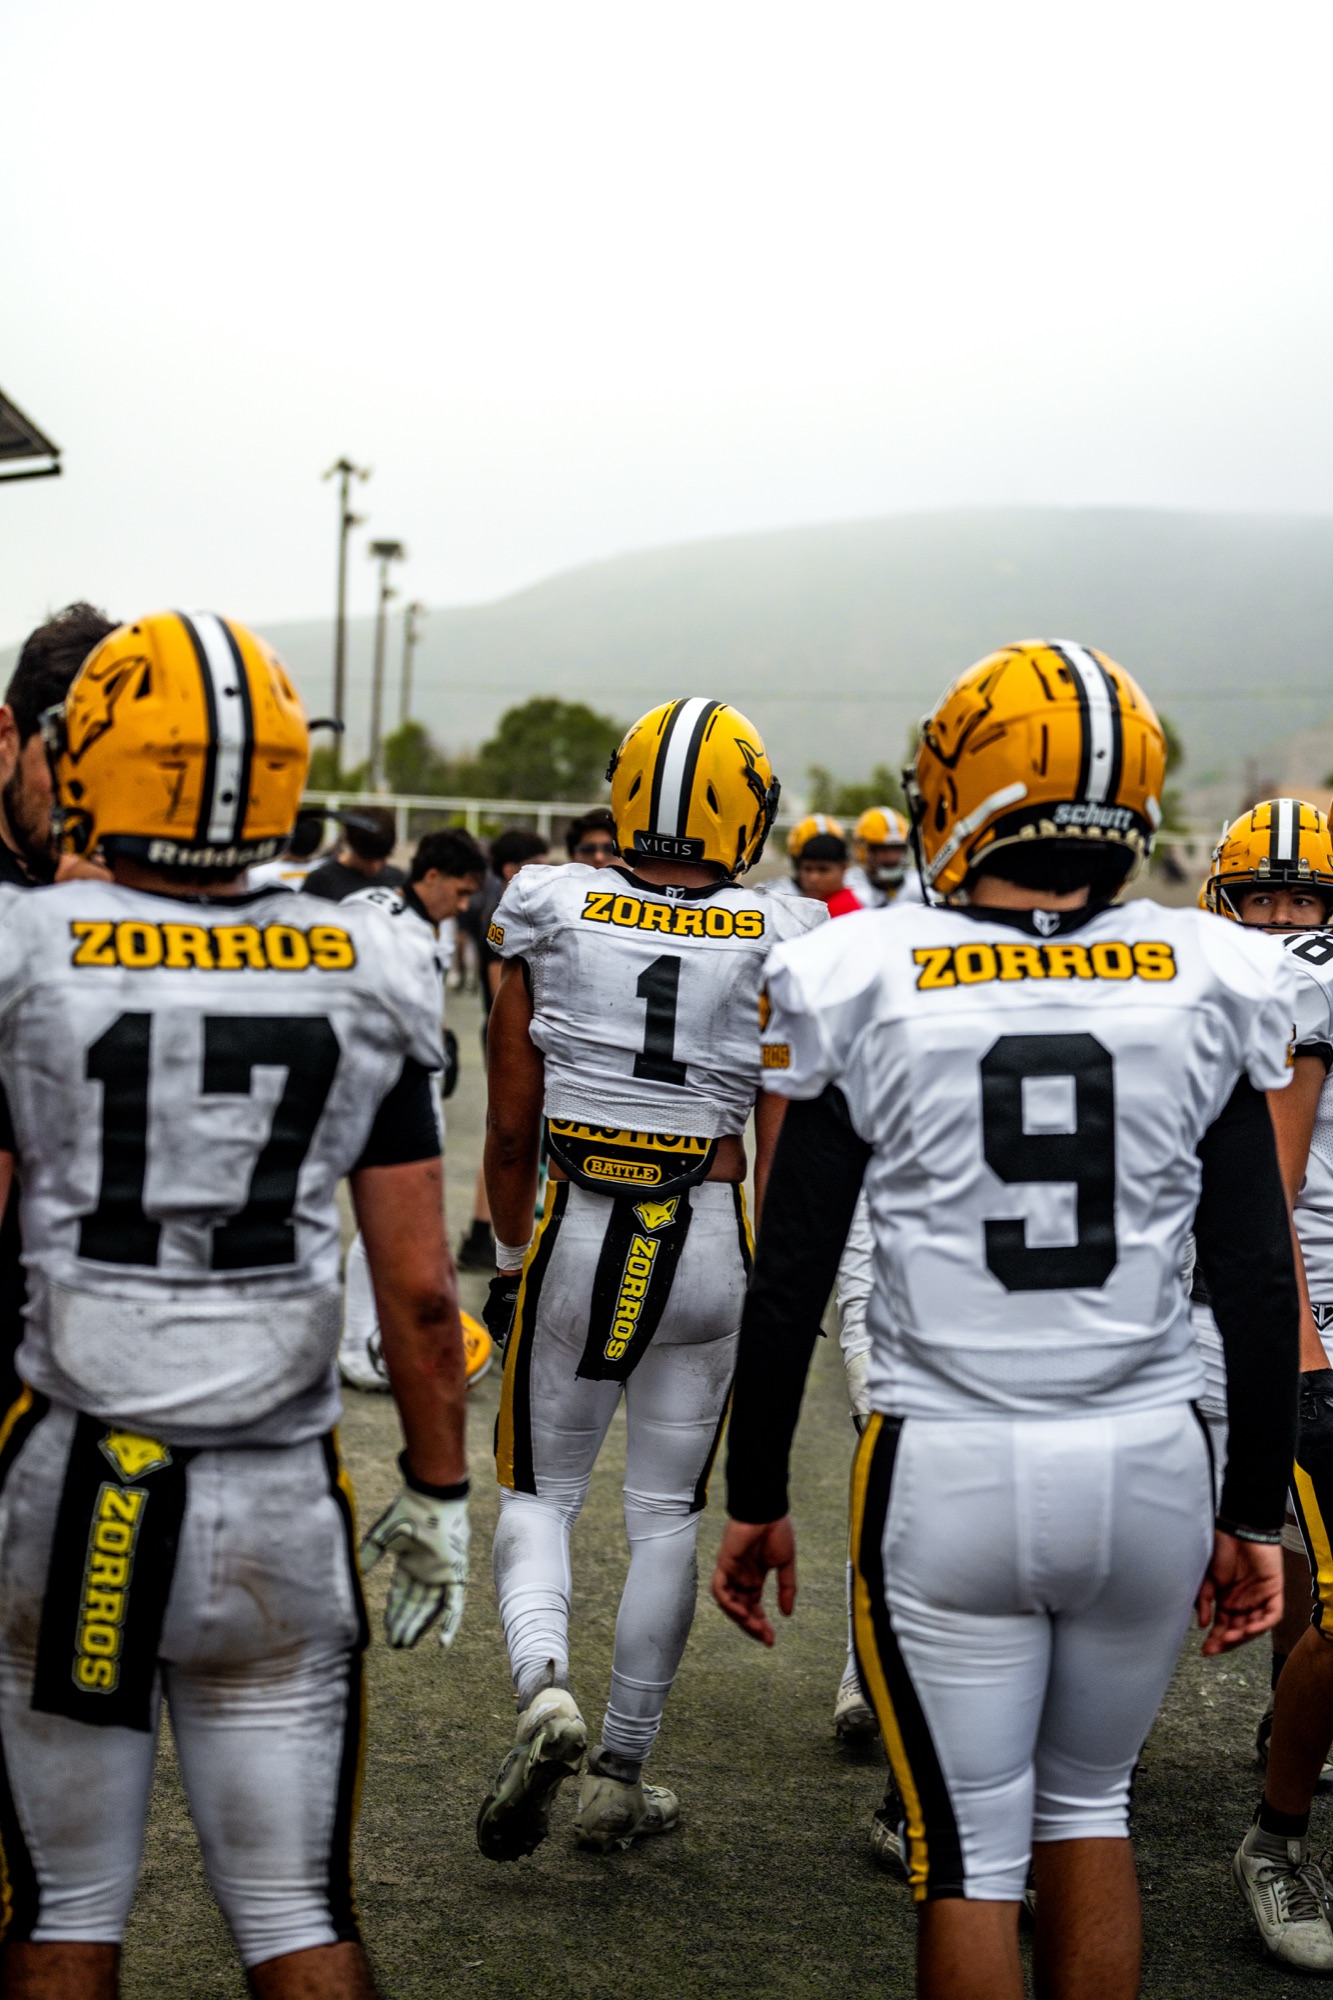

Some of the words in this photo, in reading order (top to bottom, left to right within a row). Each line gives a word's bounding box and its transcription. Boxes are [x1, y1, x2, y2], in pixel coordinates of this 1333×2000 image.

[1052, 801, 1134, 832] schutt
[640, 838, 692, 856] VICIS
[581, 891, 766, 940] ZORROS
[71, 918, 355, 972] ZORROS
[912, 940, 1178, 991] ZORROS
[632, 954, 688, 1087] 1
[78, 1011, 342, 1271] 17
[979, 1031, 1120, 1294] 9
[590, 1159, 655, 1181] BATTLE
[604, 1234, 661, 1361] ZORROS
[73, 1482, 148, 1692] ZORROS
